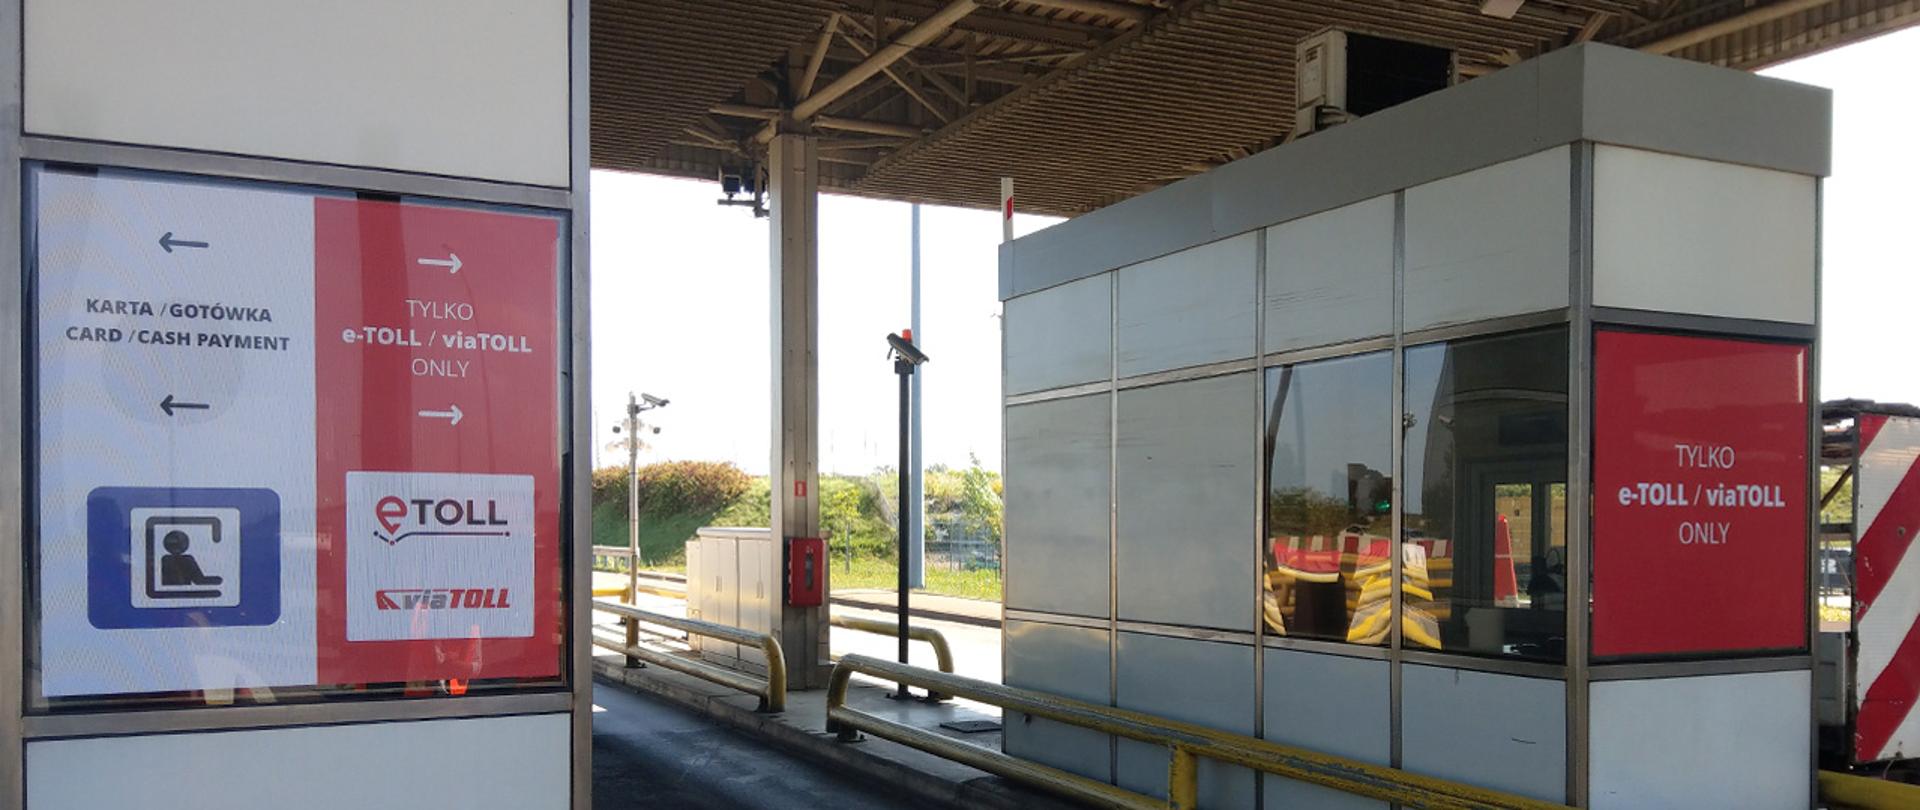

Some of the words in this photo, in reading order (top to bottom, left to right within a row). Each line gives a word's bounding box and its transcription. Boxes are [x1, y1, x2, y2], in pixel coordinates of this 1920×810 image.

[86, 299, 154, 316] KARTA
[405, 299, 474, 321] TYLKO
[65, 326, 123, 343] CARD
[197, 333, 290, 351] PAYMENT
[342, 327, 422, 346] e-TOLL
[442, 331, 532, 353] viaTOLL
[411, 358, 470, 377] ONLY
[1675, 444, 1735, 469] TYLKO
[1618, 482, 1689, 506] e-TOLL
[1706, 483, 1786, 508] viaTOLL
[1679, 521, 1730, 545] ONLY
[403, 588, 511, 609] viaTOLL
